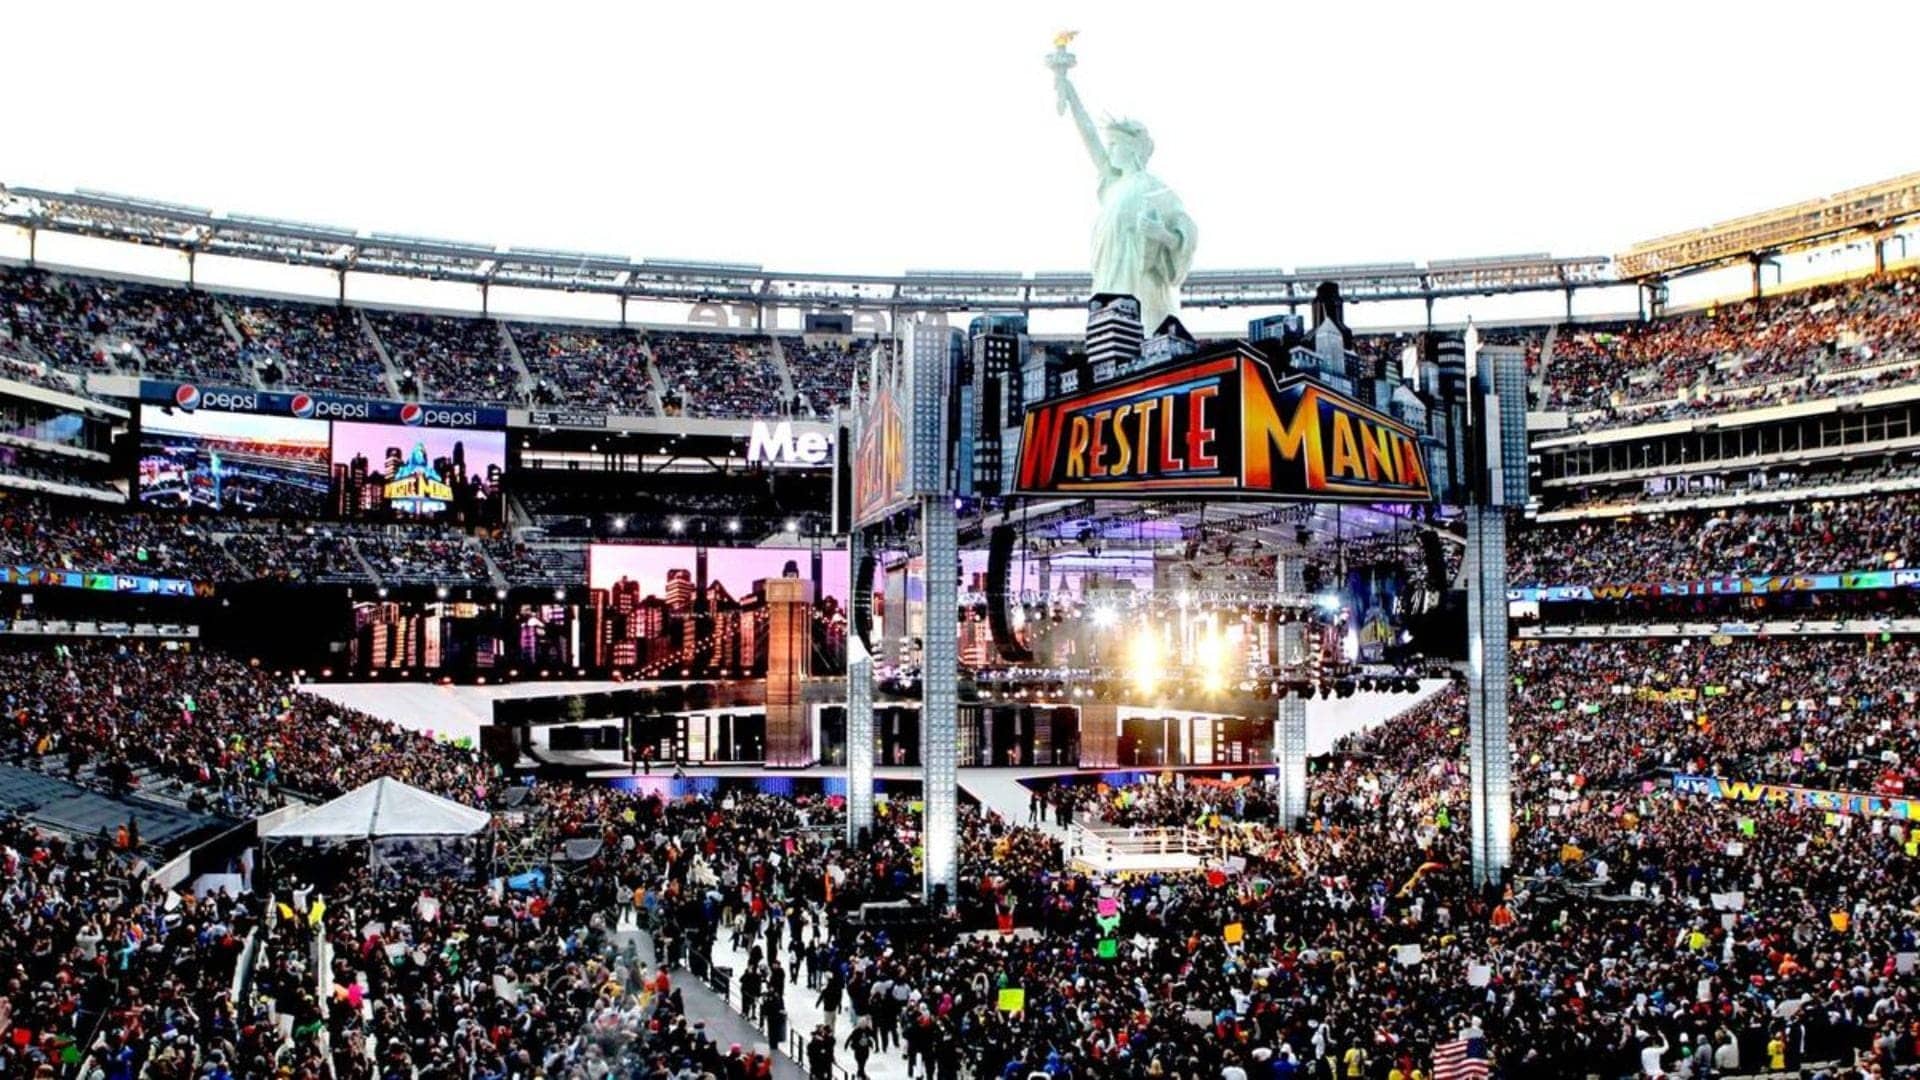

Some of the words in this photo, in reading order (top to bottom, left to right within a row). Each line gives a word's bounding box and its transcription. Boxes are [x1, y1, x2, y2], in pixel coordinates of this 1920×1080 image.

[202, 392, 258, 411] pepsi
[315, 401, 369, 419] pepsi
[424, 410, 477, 427] pepsi
[747, 420, 834, 463] Me
